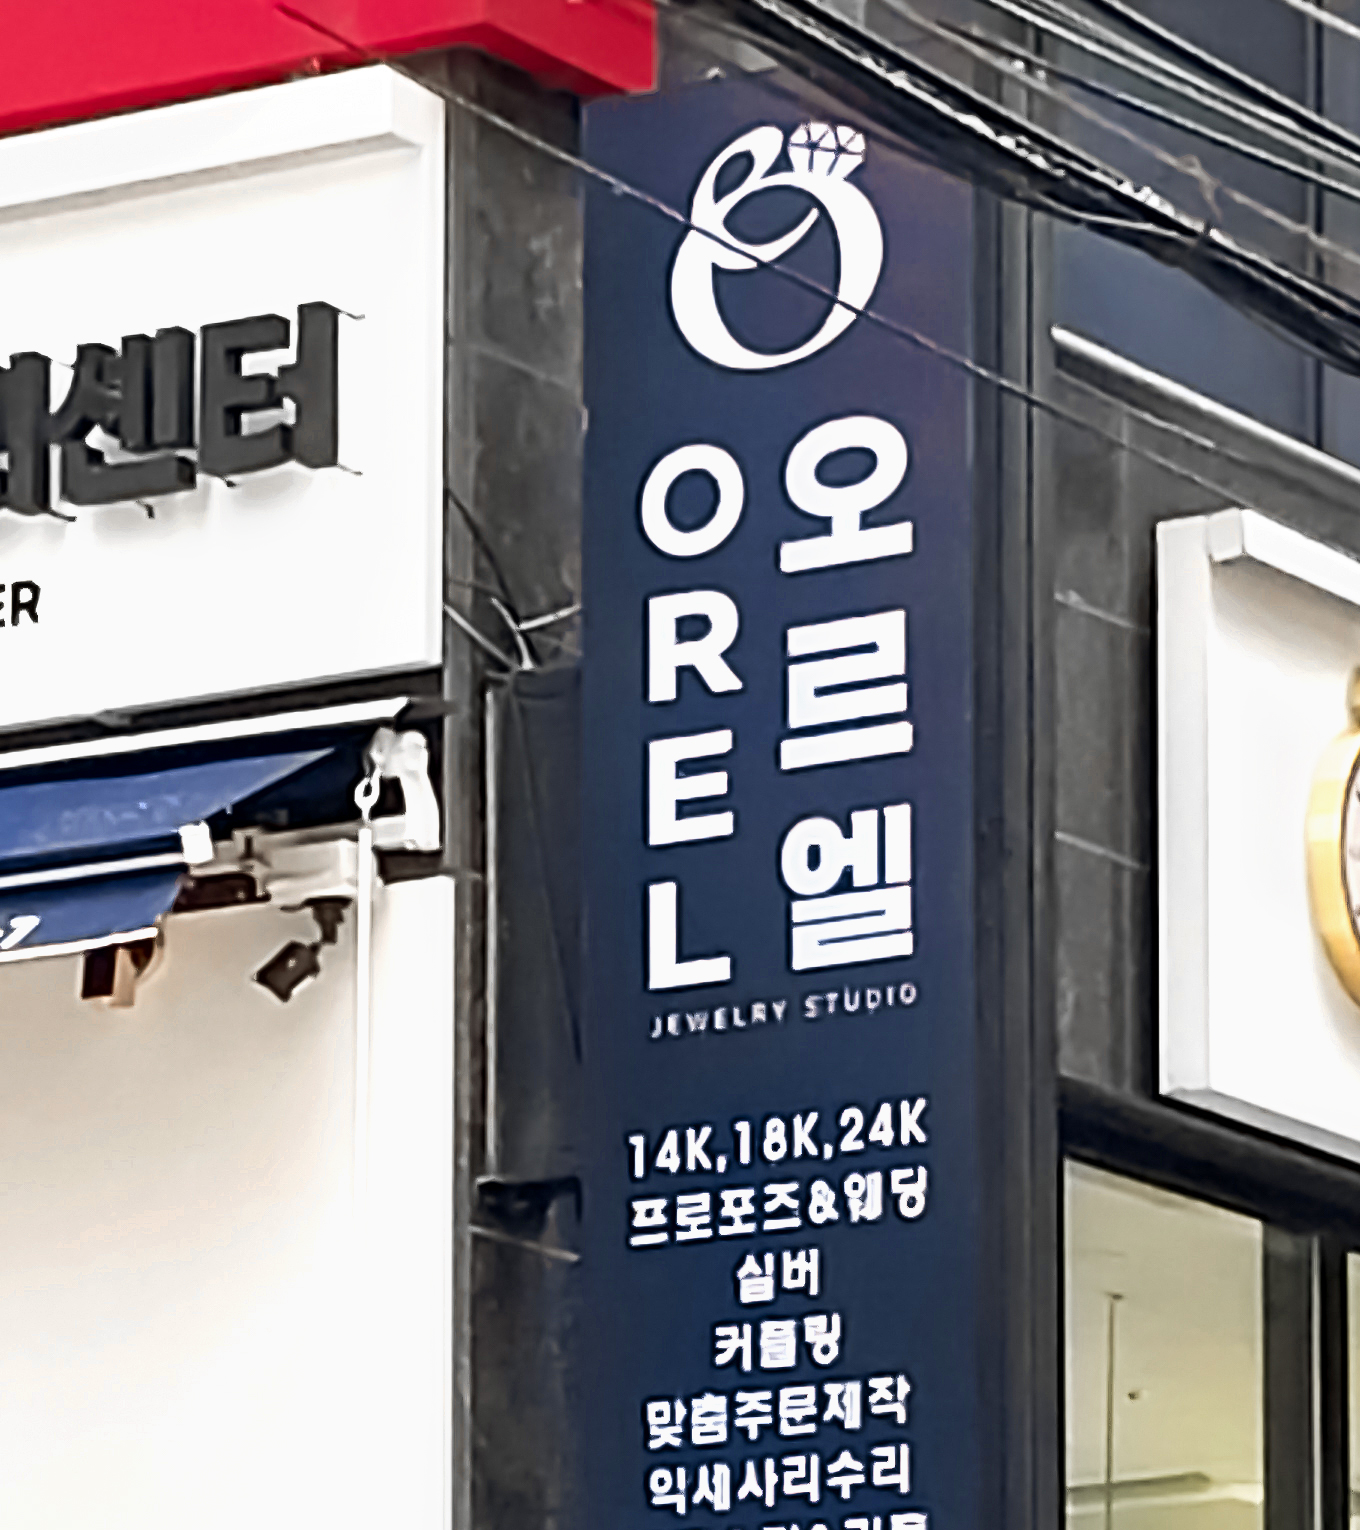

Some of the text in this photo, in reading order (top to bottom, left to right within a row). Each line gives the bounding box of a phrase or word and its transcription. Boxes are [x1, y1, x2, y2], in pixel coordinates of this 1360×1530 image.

[642, 444, 744, 989] OREL
[780, 416, 913, 970] 오르엘
[652, 984, 916, 1037] JEWELRY STUDIO
[737, 1249, 818, 1303] 실버
[716, 1313, 840, 1371] 커플링
